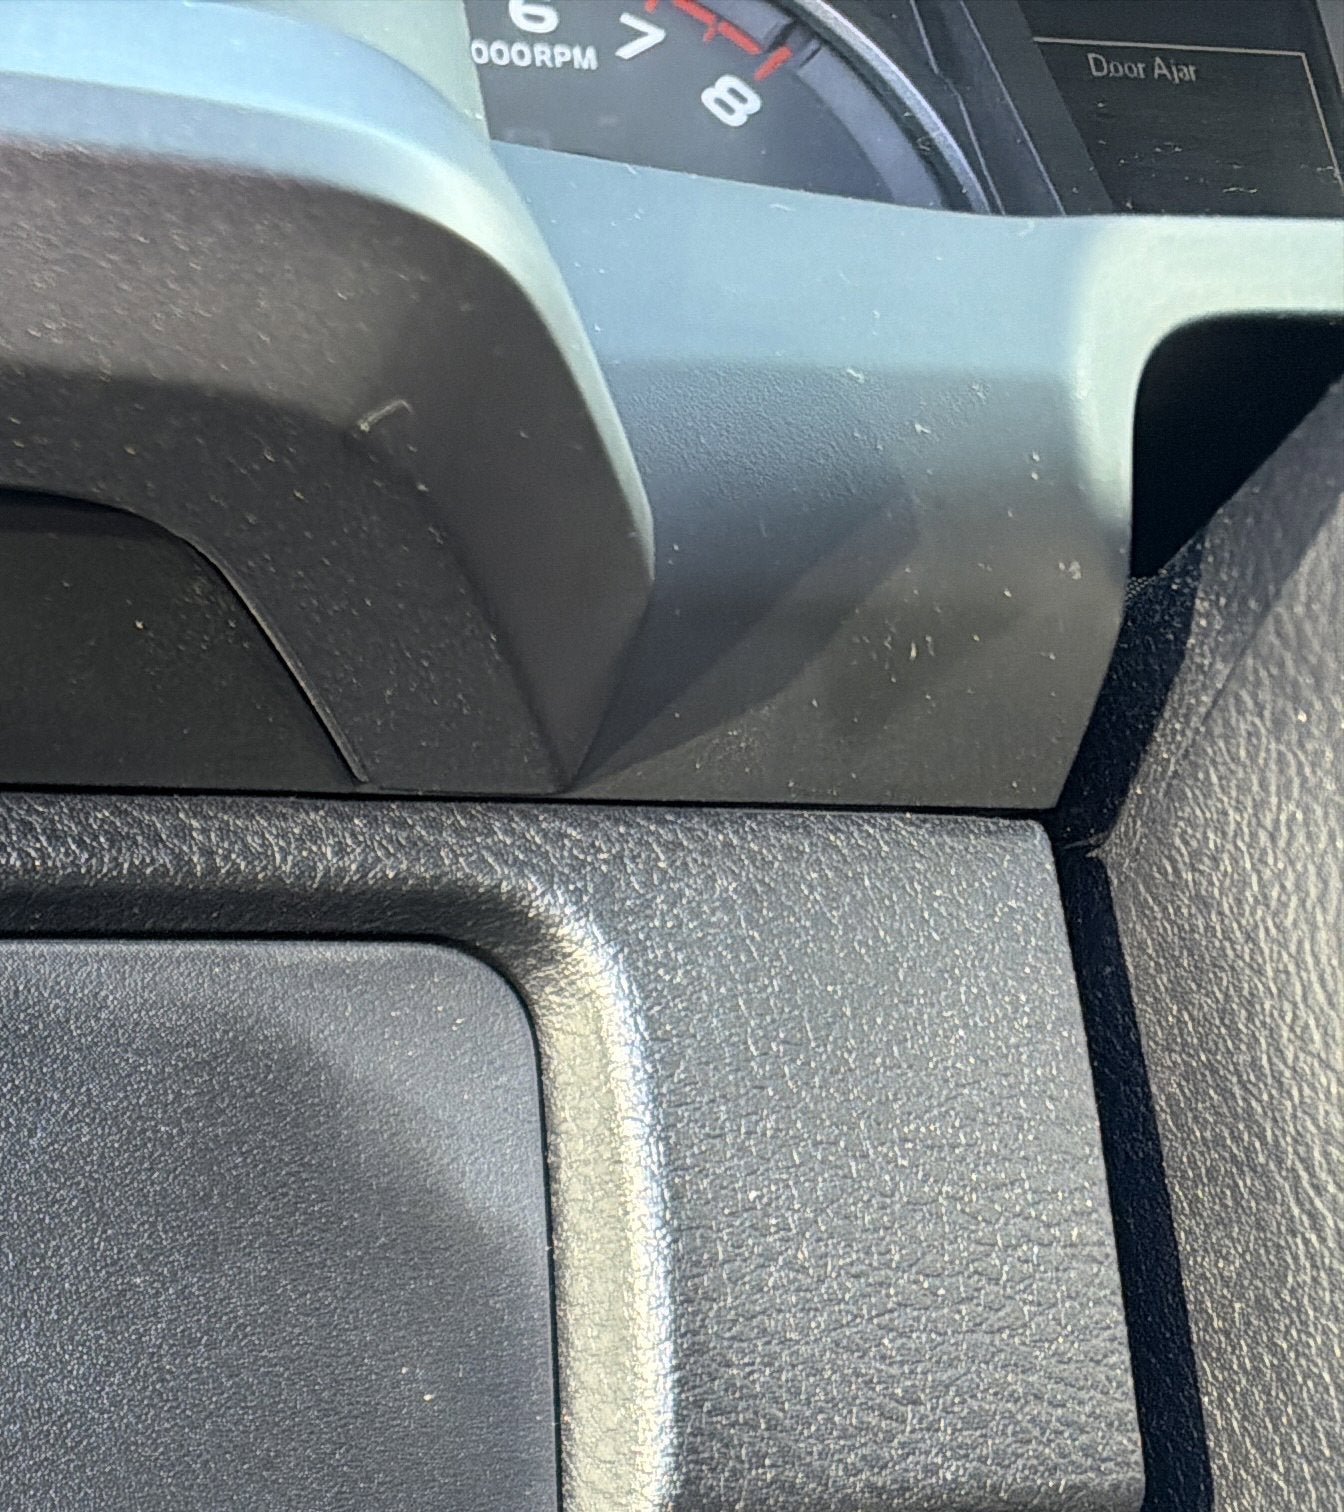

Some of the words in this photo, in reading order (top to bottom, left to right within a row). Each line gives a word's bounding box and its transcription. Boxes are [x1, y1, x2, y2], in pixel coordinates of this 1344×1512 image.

[509, 0, 559, 34] 6
[615, 12, 666, 60] 7
[1087, 52, 1146, 79] Door
[1153, 56, 1197, 85] Ajar
[701, 74, 762, 127] 8
